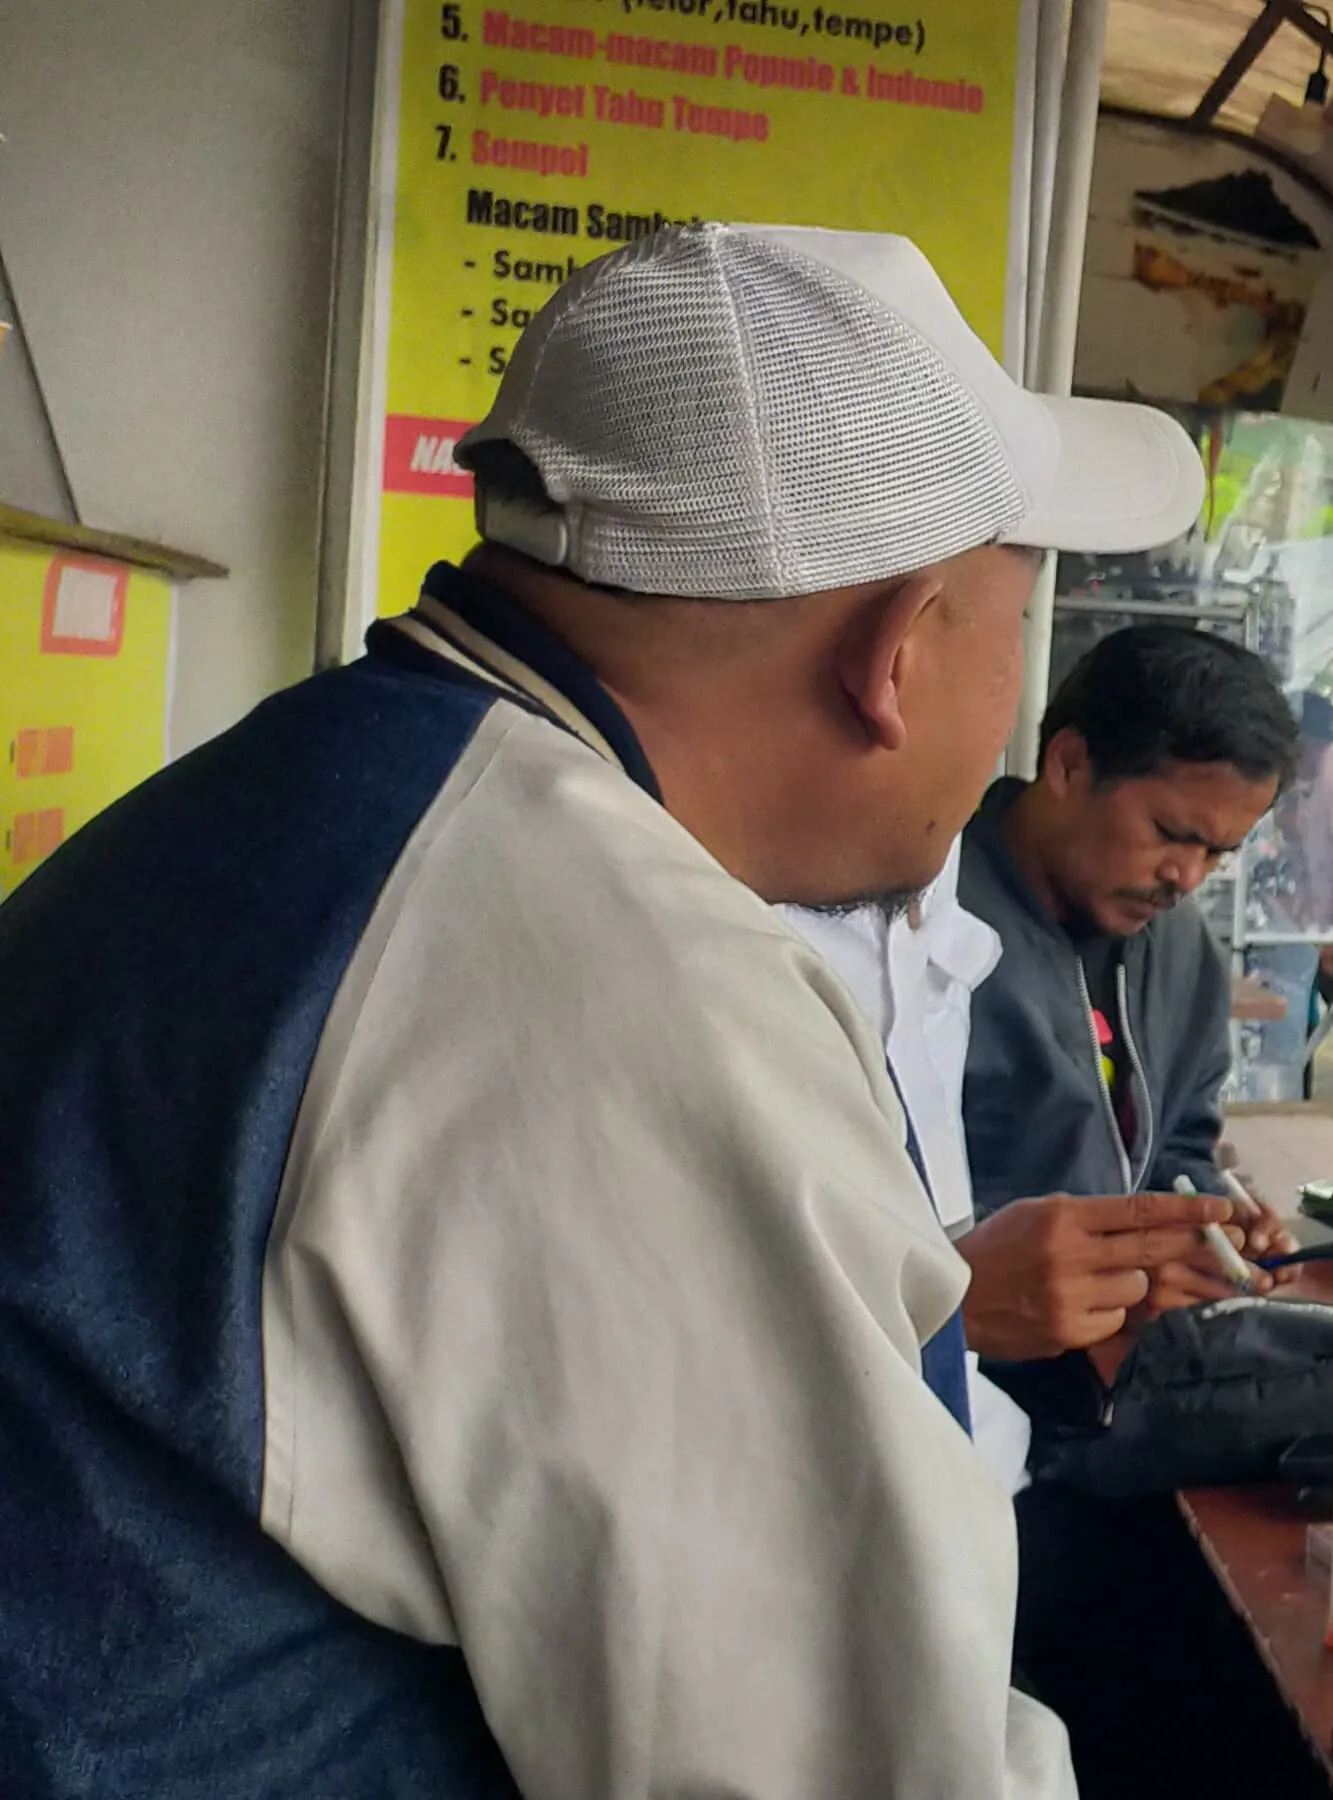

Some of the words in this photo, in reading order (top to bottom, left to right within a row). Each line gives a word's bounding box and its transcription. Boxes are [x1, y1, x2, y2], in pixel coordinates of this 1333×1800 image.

[440, 3, 469, 42] 5.
[482, 9, 718, 77] Macam-macam
[725, 44, 835, 94] Popmie
[840, 66, 861, 97] &
[866, 64, 984, 114] Indomie
[438, 63, 465, 103] 6.
[480, 67, 586, 118] Penyet
[593, 84, 665, 129] Tahu
[672, 95, 770, 142] Tempe
[435, 124, 457, 162] 7.
[471, 128, 589, 178] Sempol
[466, 189, 579, 237] Macam
